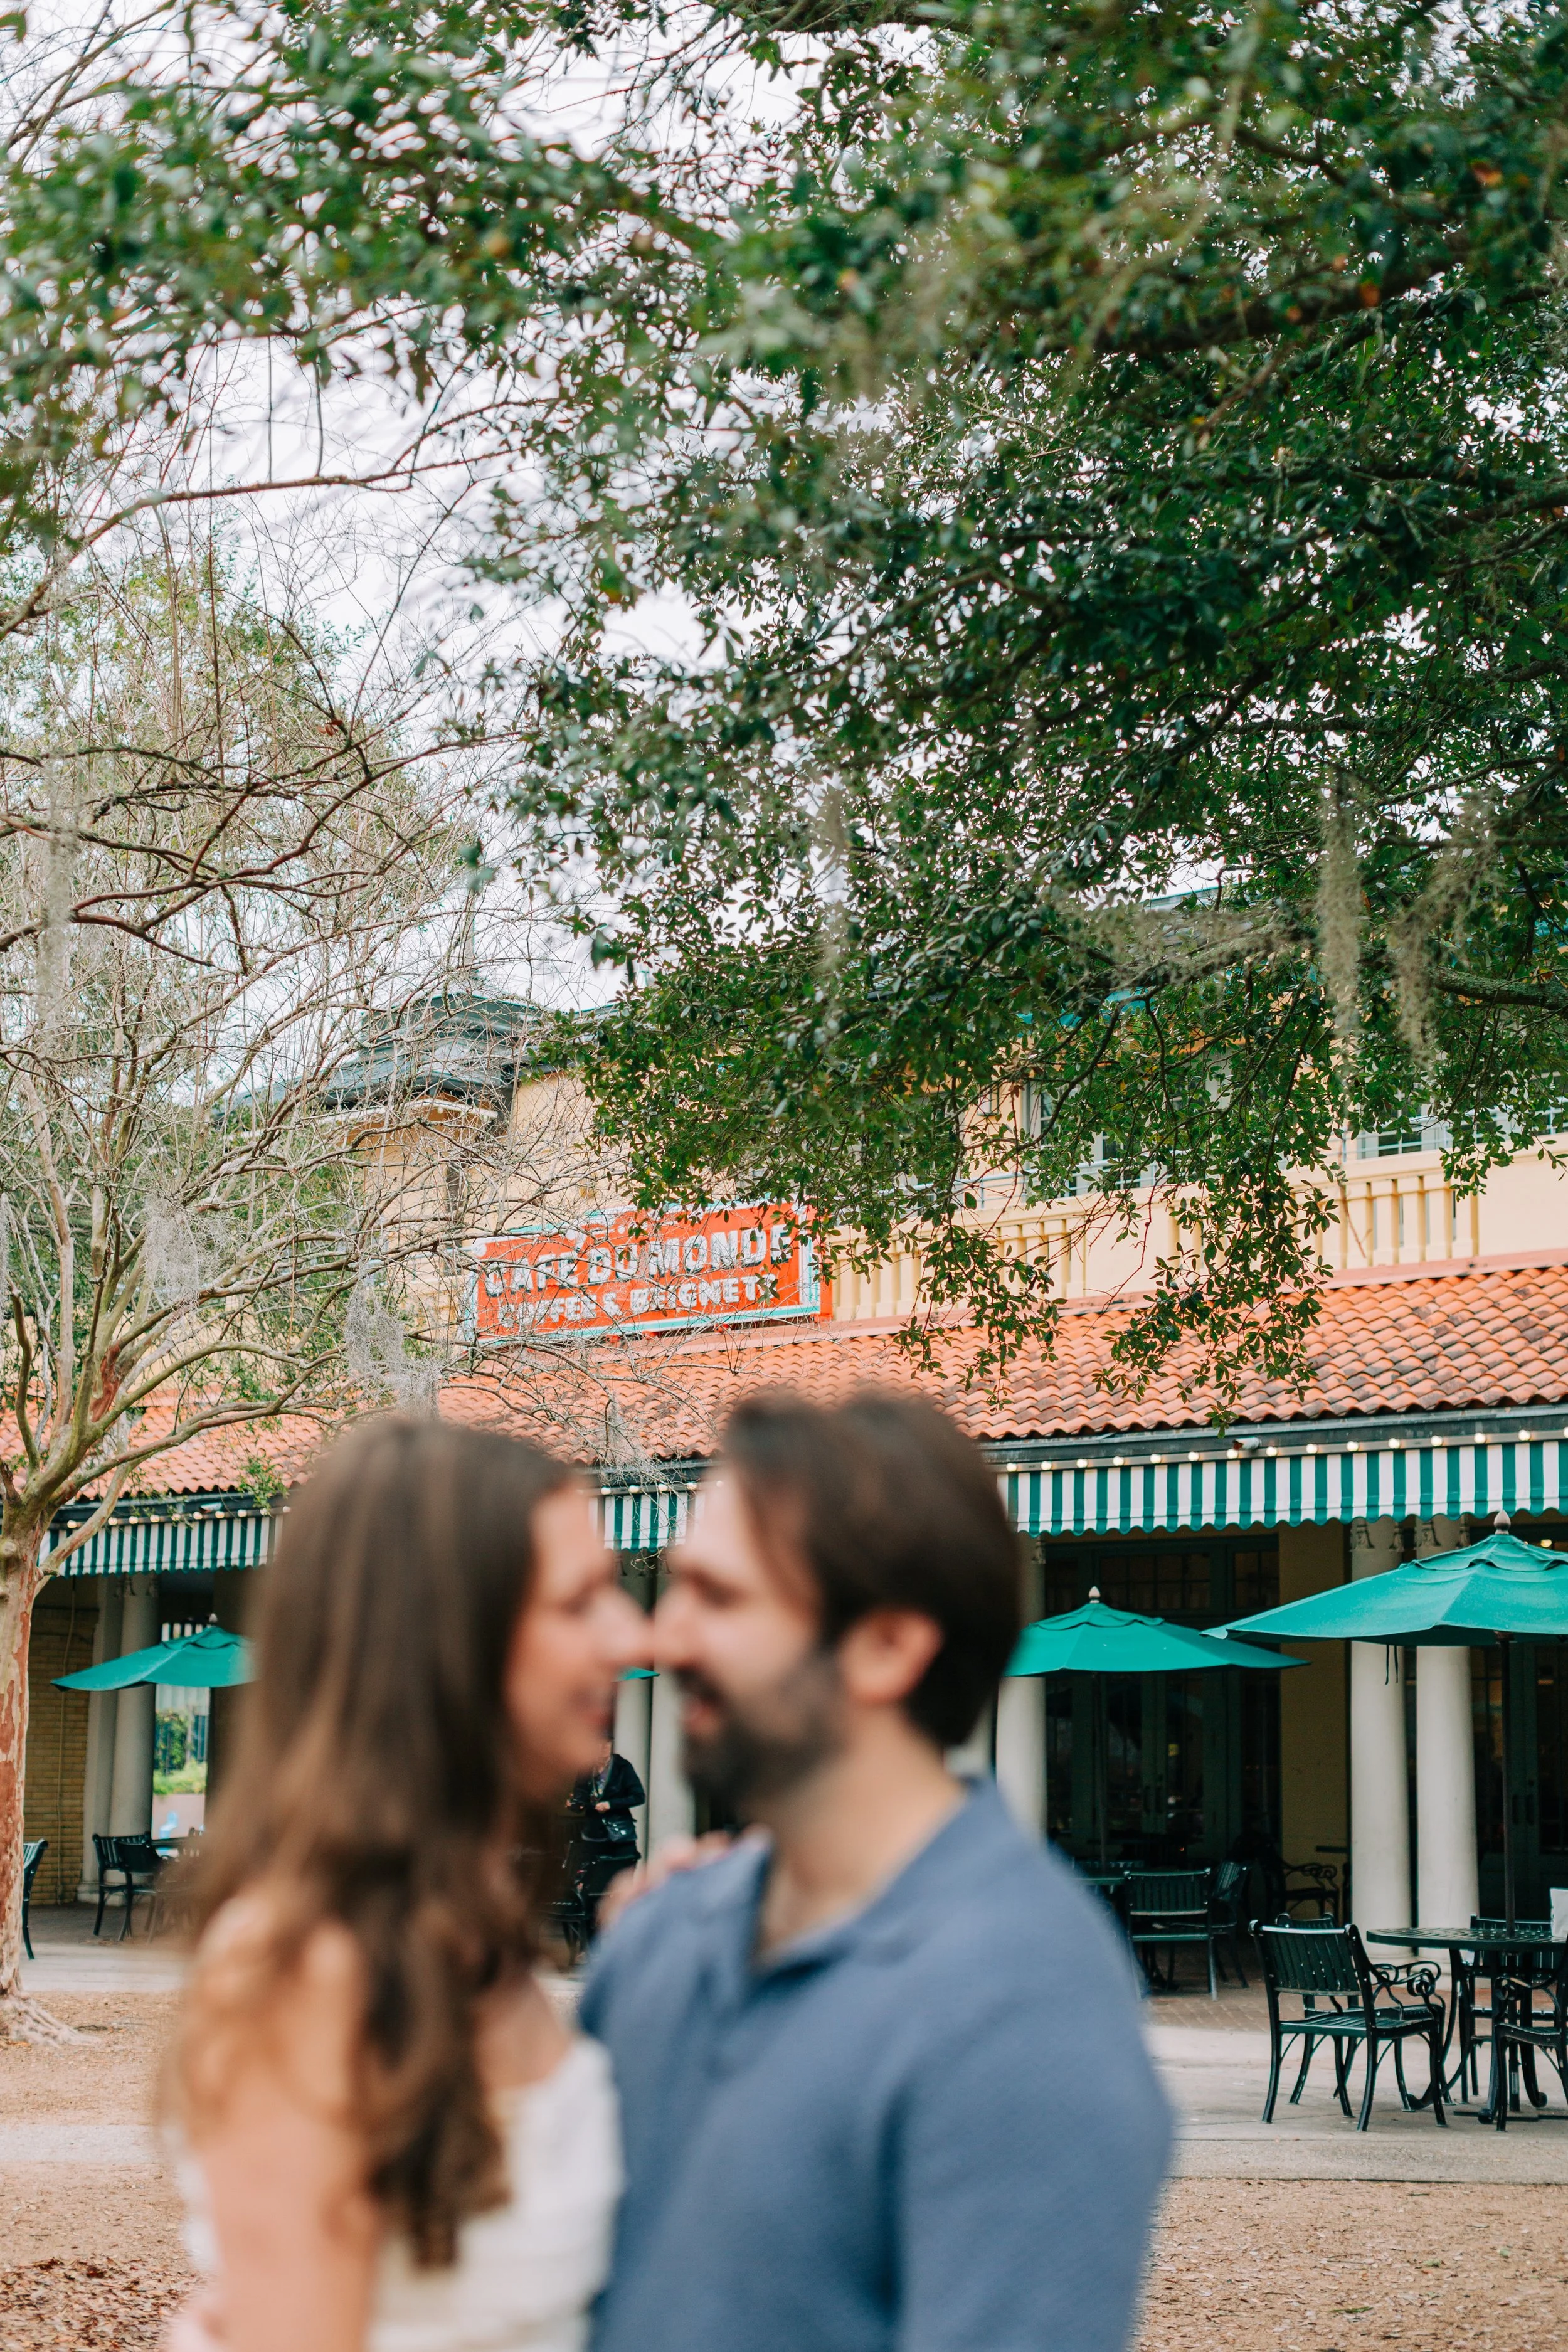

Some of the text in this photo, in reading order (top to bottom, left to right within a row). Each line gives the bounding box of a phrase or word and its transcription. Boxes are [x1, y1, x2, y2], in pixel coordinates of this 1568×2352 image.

[587, 1243, 638, 1285] DU
[647, 1224, 792, 1279] MONDE
[603, 1291, 623, 1318] &
